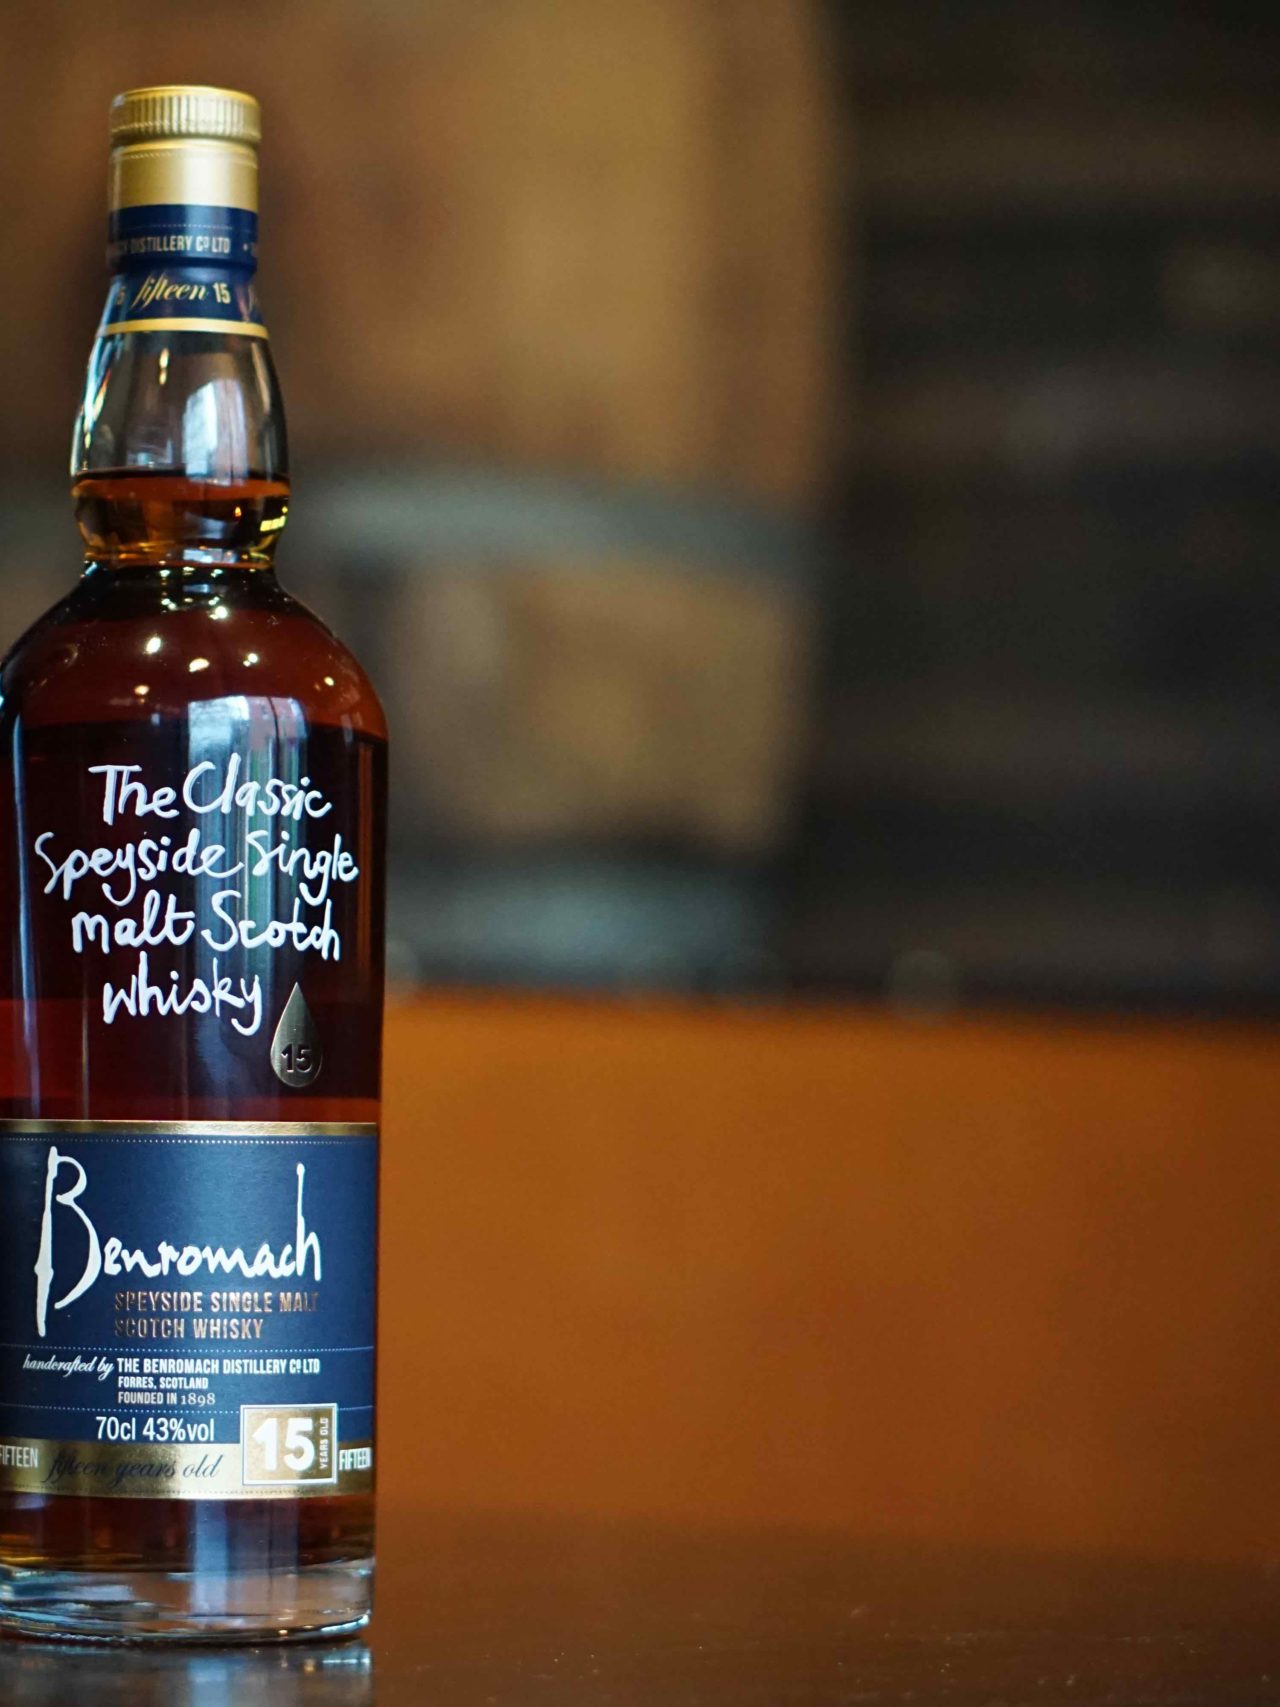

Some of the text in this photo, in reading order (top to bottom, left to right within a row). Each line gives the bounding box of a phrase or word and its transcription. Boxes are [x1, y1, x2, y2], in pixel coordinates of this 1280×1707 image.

[131, 235, 190, 253] DISTILLERY
[213, 237, 231, 254] LTD
[131, 272, 232, 309] fifteen 15
[88, 752, 332, 826] The Classic
[34, 828, 360, 907] Speyside Single
[201, 889, 341, 961] Scotch
[280, 1044, 314, 1074] 15
[33, 1145, 323, 1338] Benromach
[114, 1291, 320, 1313] SPEYSIDE SINGLE MALT
[114, 1318, 264, 1339] SCOTCH WHISKY
[22, 1353, 98, 1379] handcrafted
[96, 1356, 114, 1382] by
[117, 1357, 140, 1373] THE
[143, 1358, 219, 1374] BENROMACH
[223, 1358, 287, 1374] DISTILLERY
[303, 1358, 320, 1373] LTD
[118, 1376, 209, 1389] FORRES, SCOTLAND
[118, 1391, 216, 1407] FOUNDED IN 1898
[95, 1416, 136, 1440] 70cl
[252, 1417, 316, 1472] 15
[320, 1417, 329, 1469] YEARS OLD
[44, 1450, 223, 1488] fifteen years old
